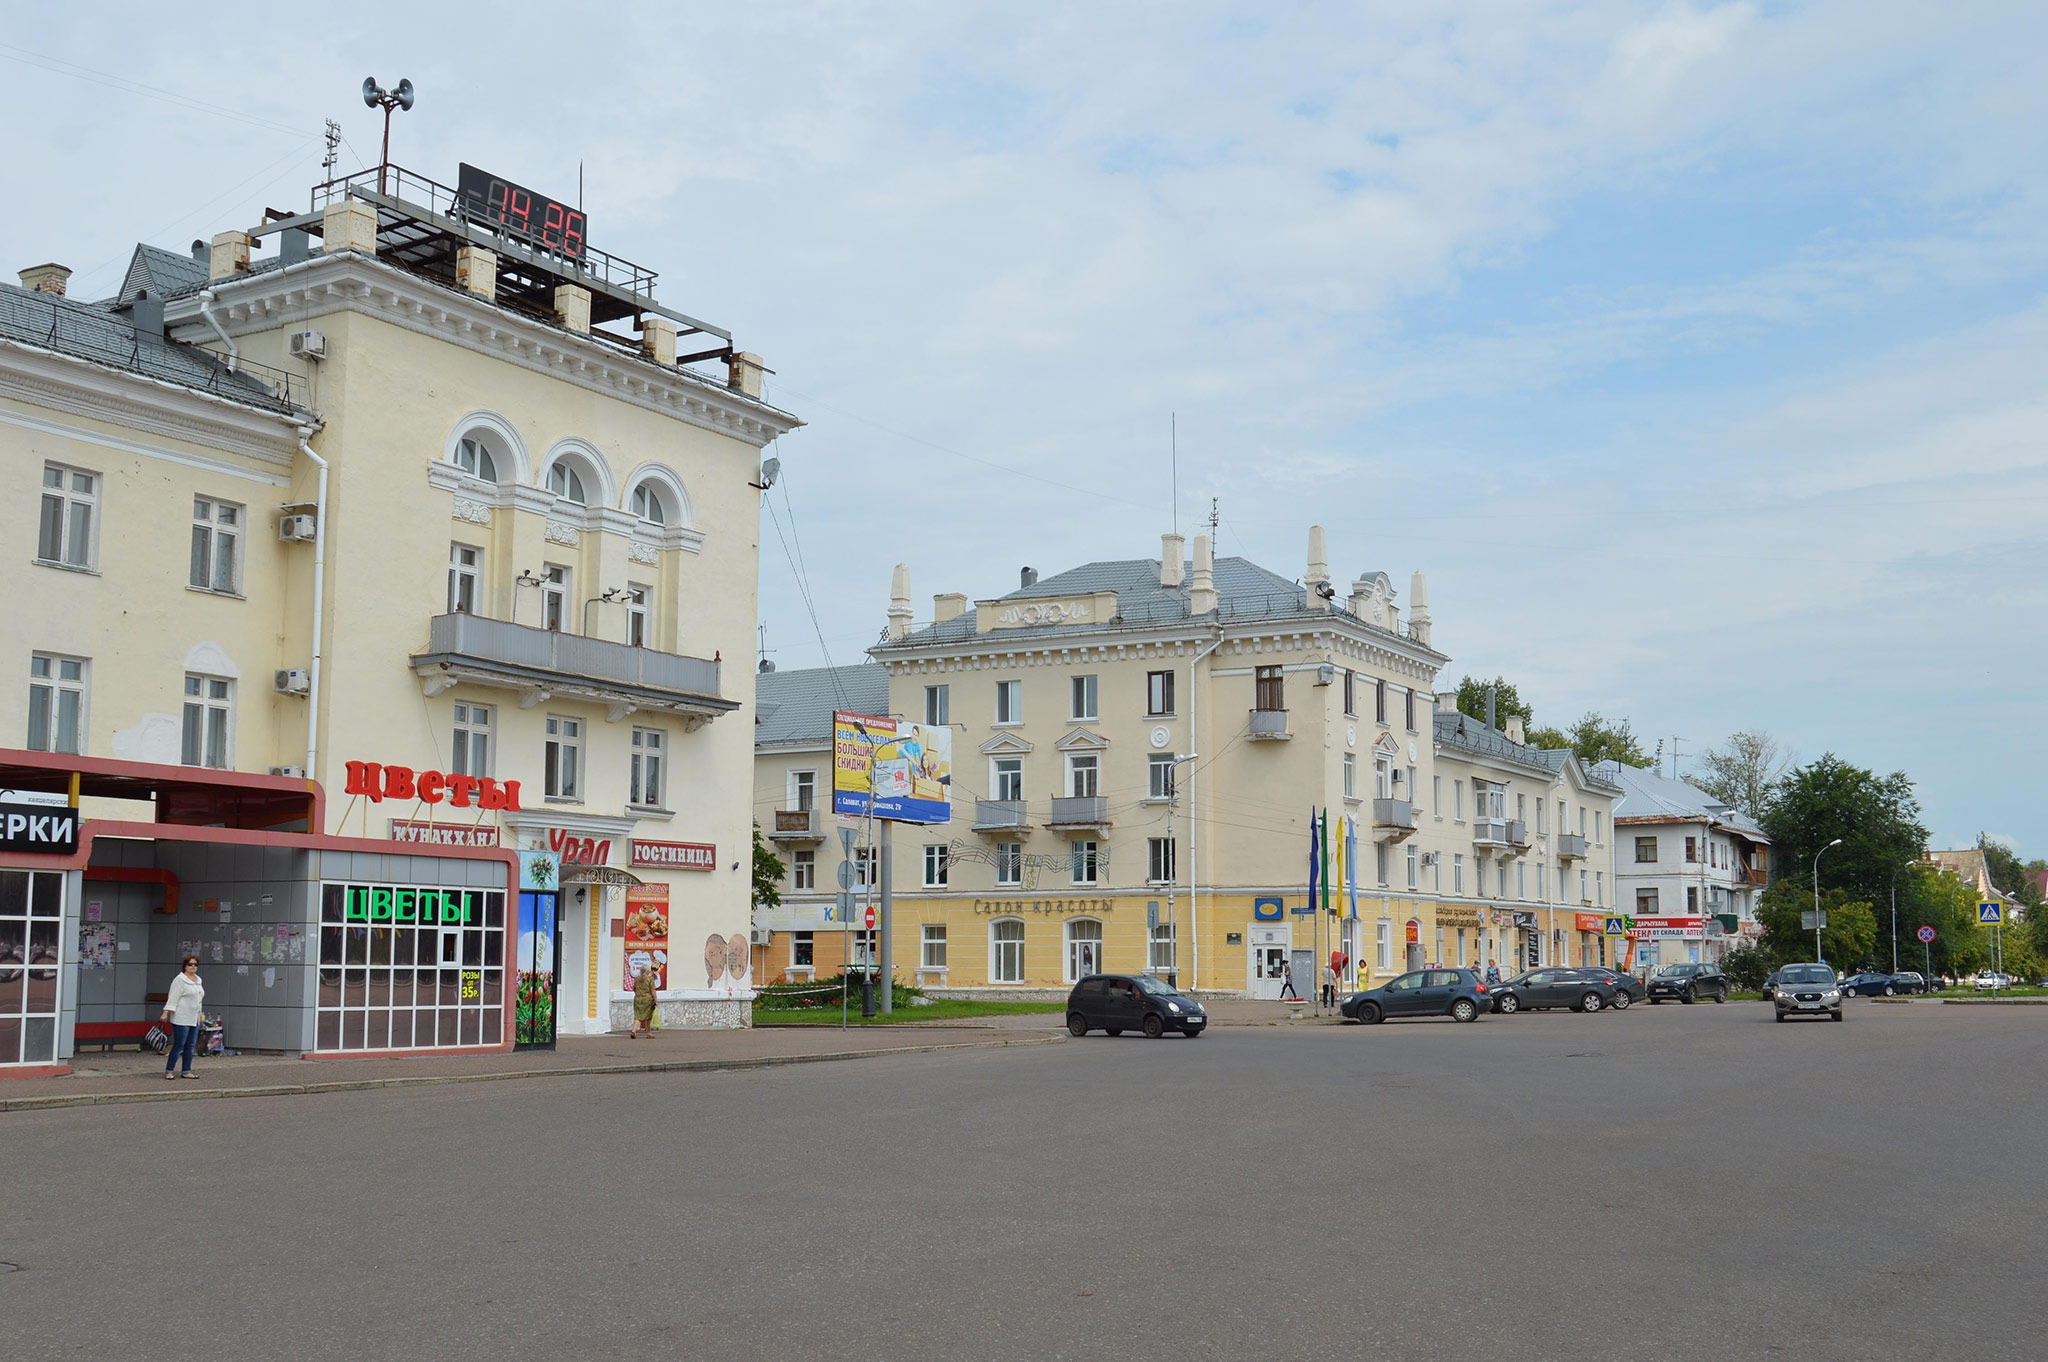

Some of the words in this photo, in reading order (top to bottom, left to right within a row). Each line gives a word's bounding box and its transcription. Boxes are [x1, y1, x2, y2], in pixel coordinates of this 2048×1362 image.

[837, 729, 855, 741] ВСЕМ
[837, 757, 867, 772] СКИДКИ
[0, 813, 72, 843] РКИ
[634, 844, 714, 867] ГОСТИНИЦА
[347, 889, 472, 922] ЦВЕТЫ
[462, 971, 480, 980] РОЗЫ
